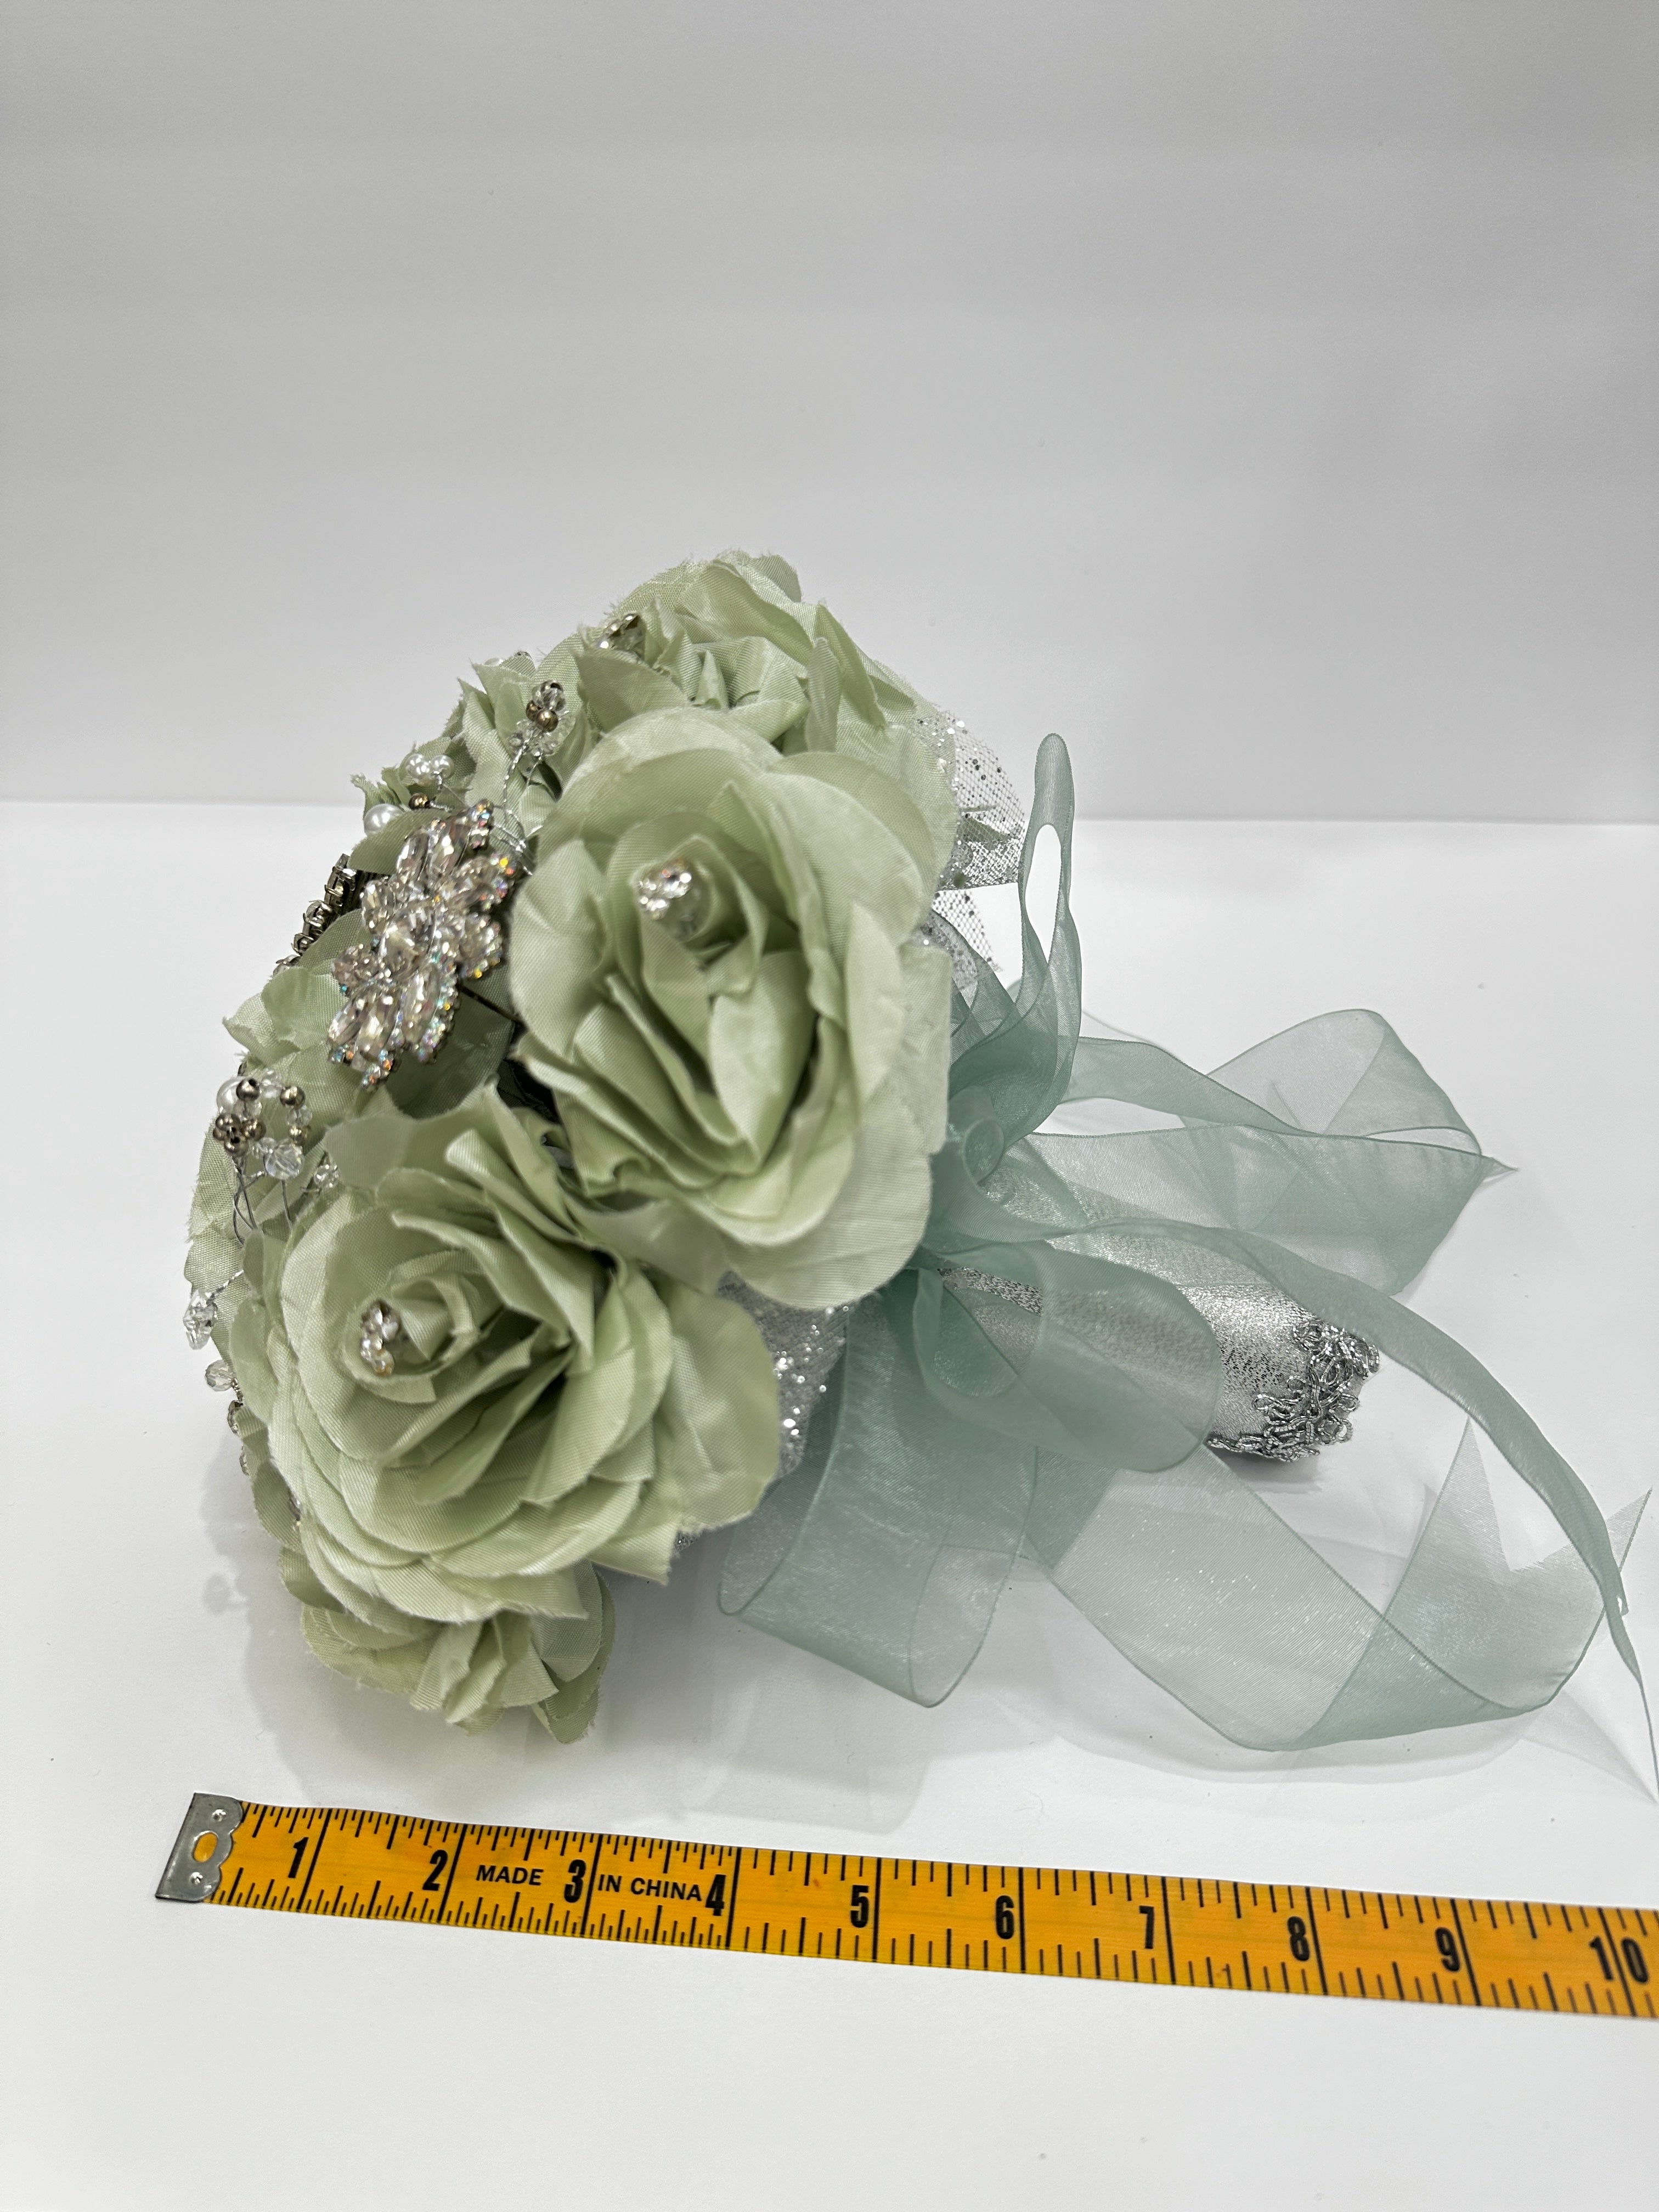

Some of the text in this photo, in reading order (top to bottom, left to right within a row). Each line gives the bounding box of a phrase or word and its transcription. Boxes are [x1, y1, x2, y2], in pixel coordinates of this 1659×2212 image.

[287, 1836, 309, 1878] 1
[422, 1849, 449, 1892] 2
[475, 1864, 702, 1901] MADE IN CHINA
[563, 1859, 586, 1903] 3
[704, 1874, 726, 1916] 4
[850, 1884, 870, 1928] 5
[995, 1894, 1015, 1940] 6
[1139, 1905, 1155, 1950] 7
[1287, 1916, 1311, 1961] 8
[1435, 1927, 1461, 1972] 9
[1589, 1936, 1649, 1983] 10
